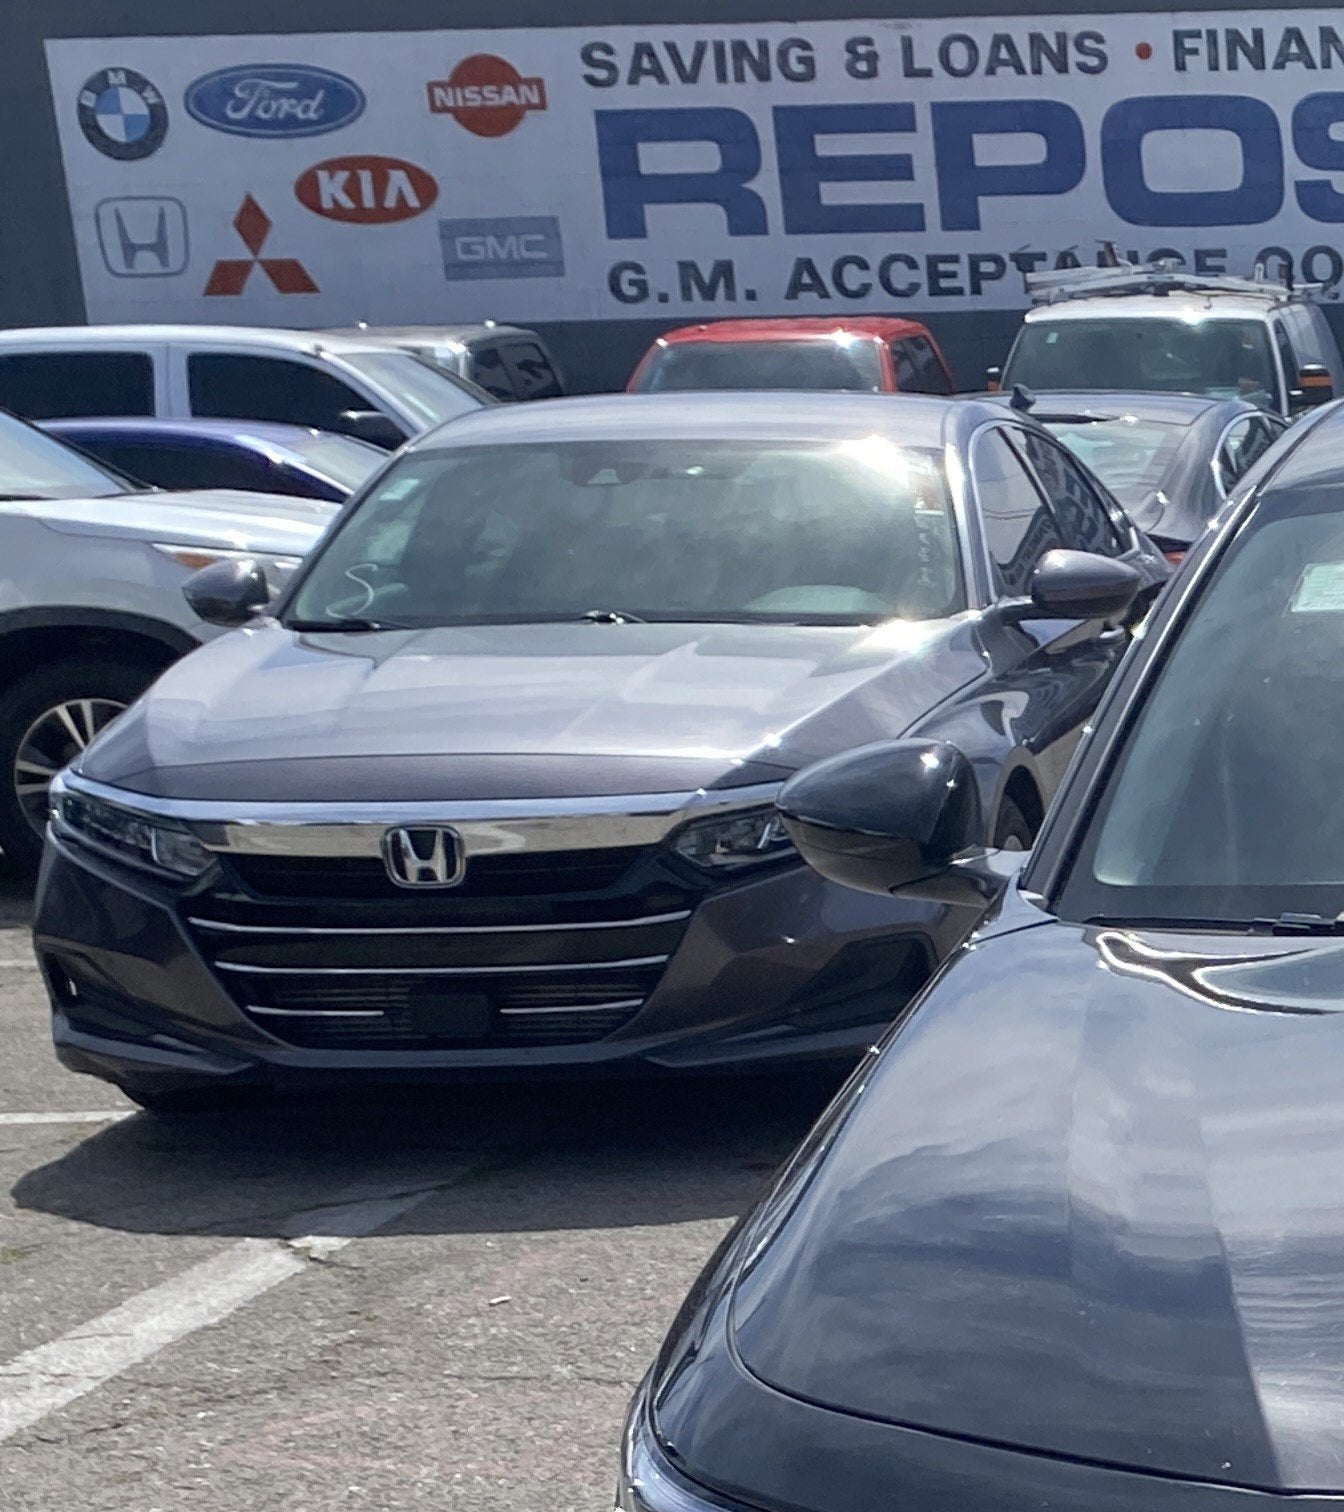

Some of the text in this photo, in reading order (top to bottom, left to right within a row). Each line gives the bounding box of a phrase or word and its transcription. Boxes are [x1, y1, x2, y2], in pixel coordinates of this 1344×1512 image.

[580, 37, 818, 89] SAVING
[844, 36, 880, 80] &
[900, 31, 1109, 80] LOANS
[225, 77, 326, 120] Ford
[432, 84, 541, 108] NISSAN
[315, 169, 422, 210] KIA
[454, 233, 550, 262] GMC
[607, 259, 757, 305] G.M.
